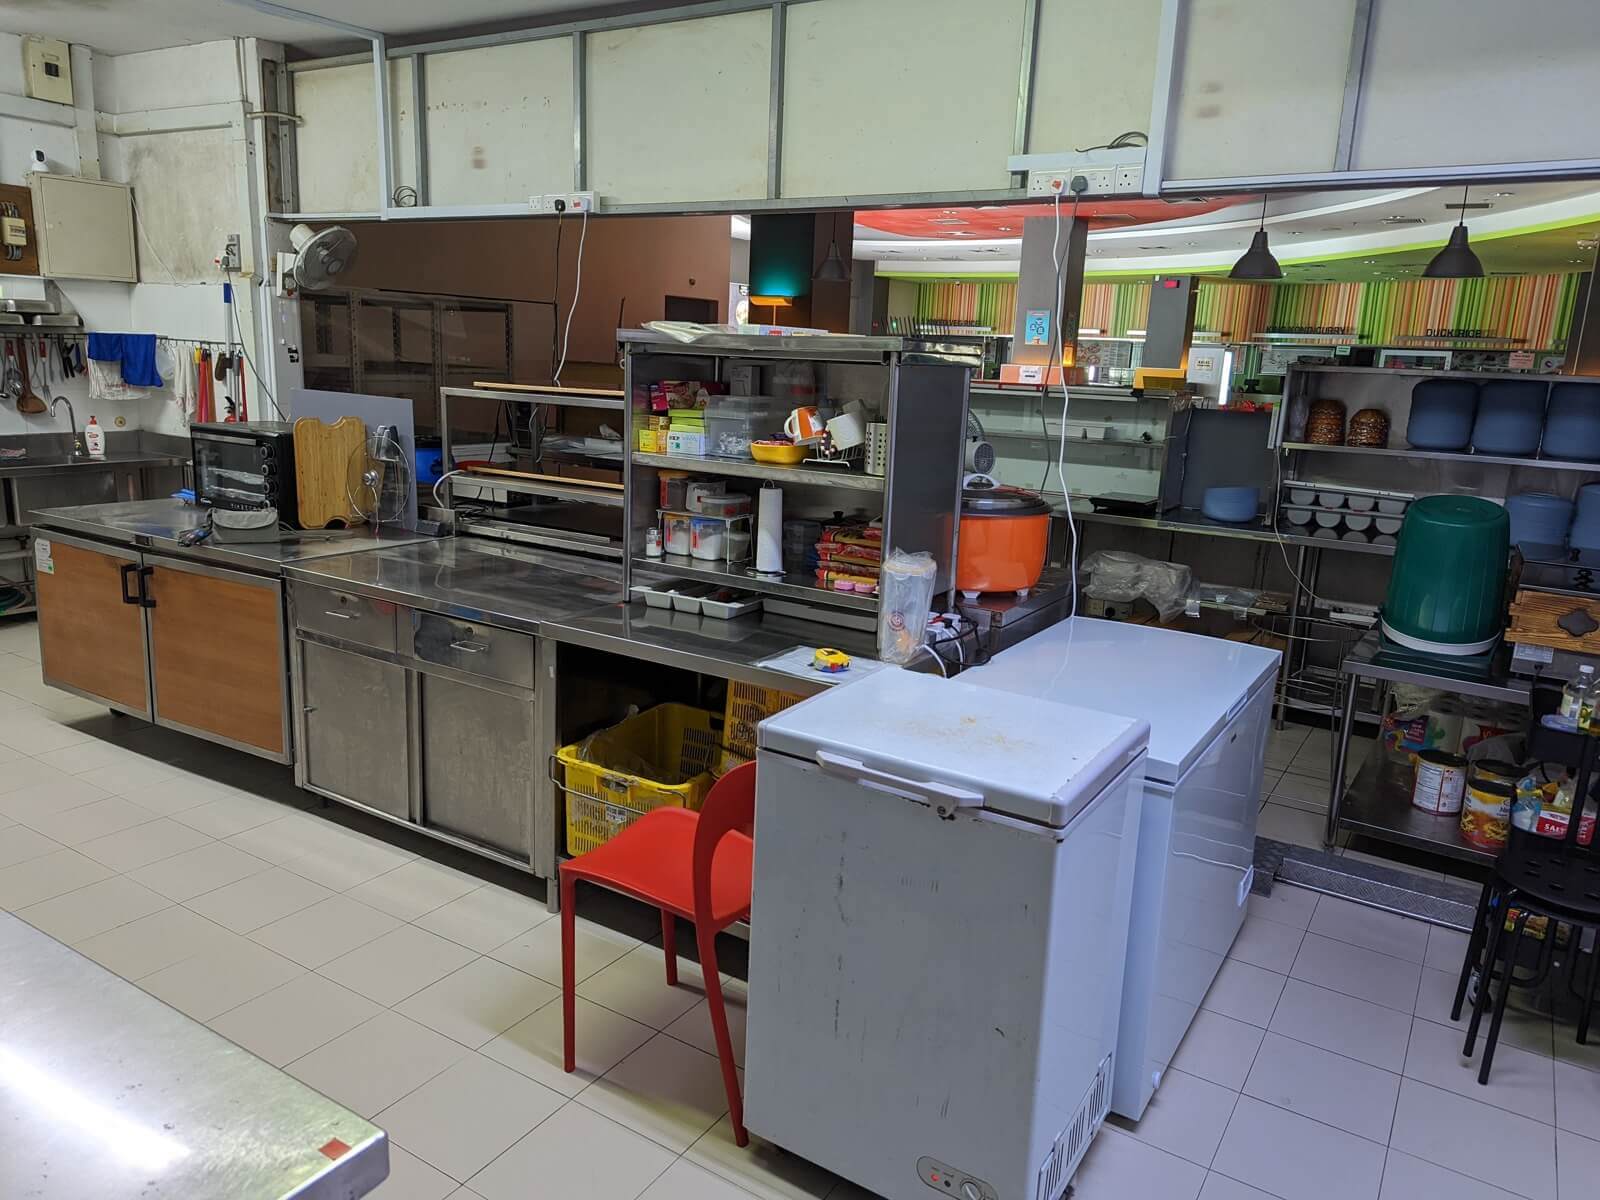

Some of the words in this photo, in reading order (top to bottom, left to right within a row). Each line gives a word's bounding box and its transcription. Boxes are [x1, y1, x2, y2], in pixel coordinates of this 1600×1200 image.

[1426, 328, 1453, 337] DUCK
[1457, 329, 1482, 338] RICE
[1544, 823, 1567, 835] SALT
